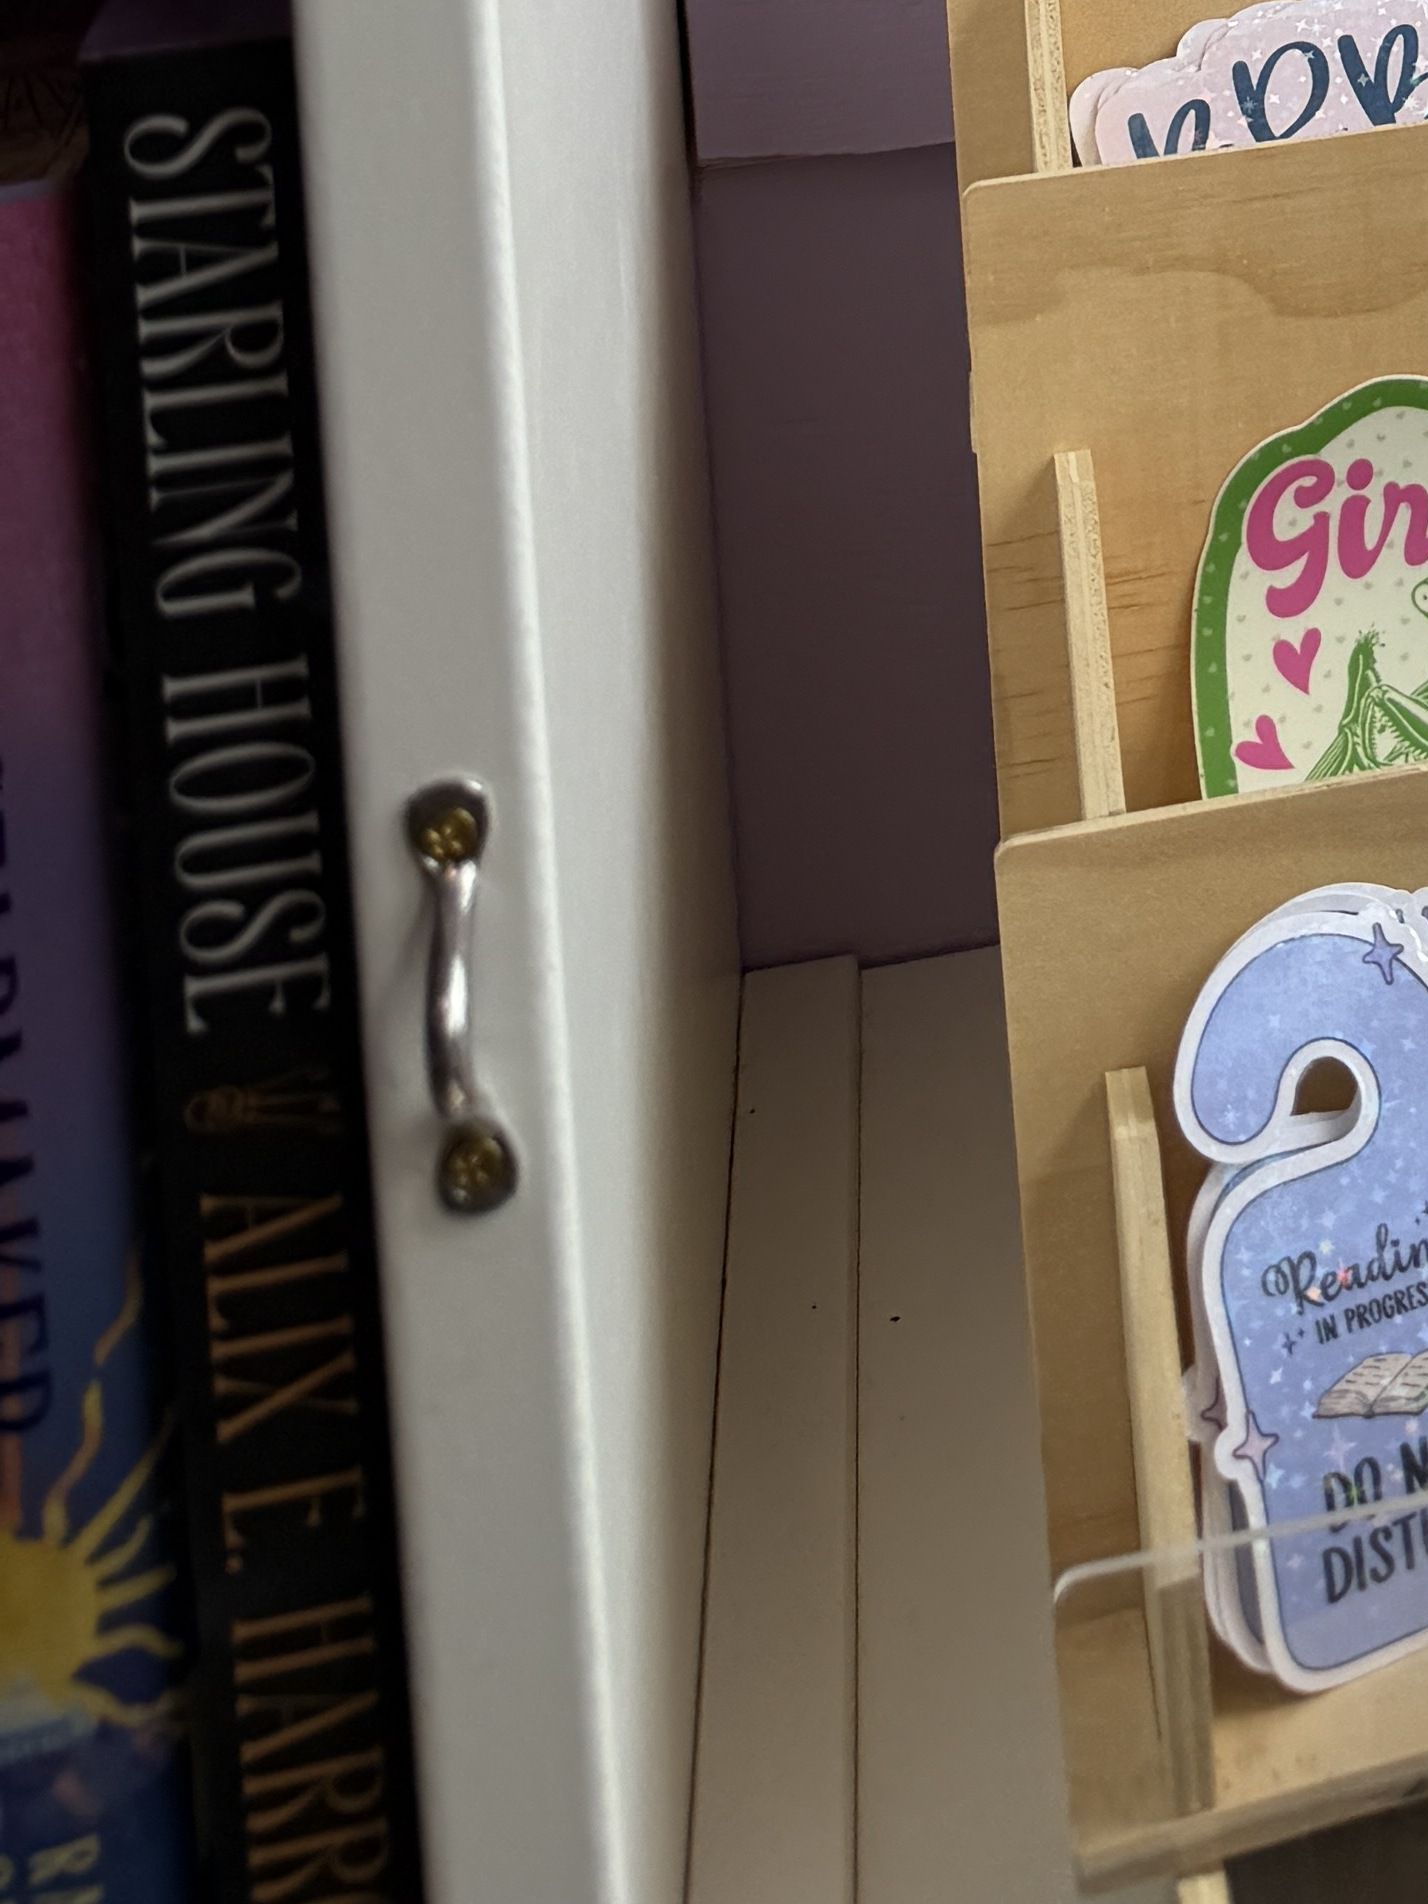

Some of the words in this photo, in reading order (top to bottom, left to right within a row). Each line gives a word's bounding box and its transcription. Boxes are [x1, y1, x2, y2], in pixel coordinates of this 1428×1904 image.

[122, 105, 303, 617] STARLING
[161, 655, 334, 1034] HOUSE
[201, 1192, 361, 1444] ALIX
[1315, 1315, 1340, 1345] IN
[222, 1467, 367, 1575] E.
[1322, 1454, 1386, 1534] DO
